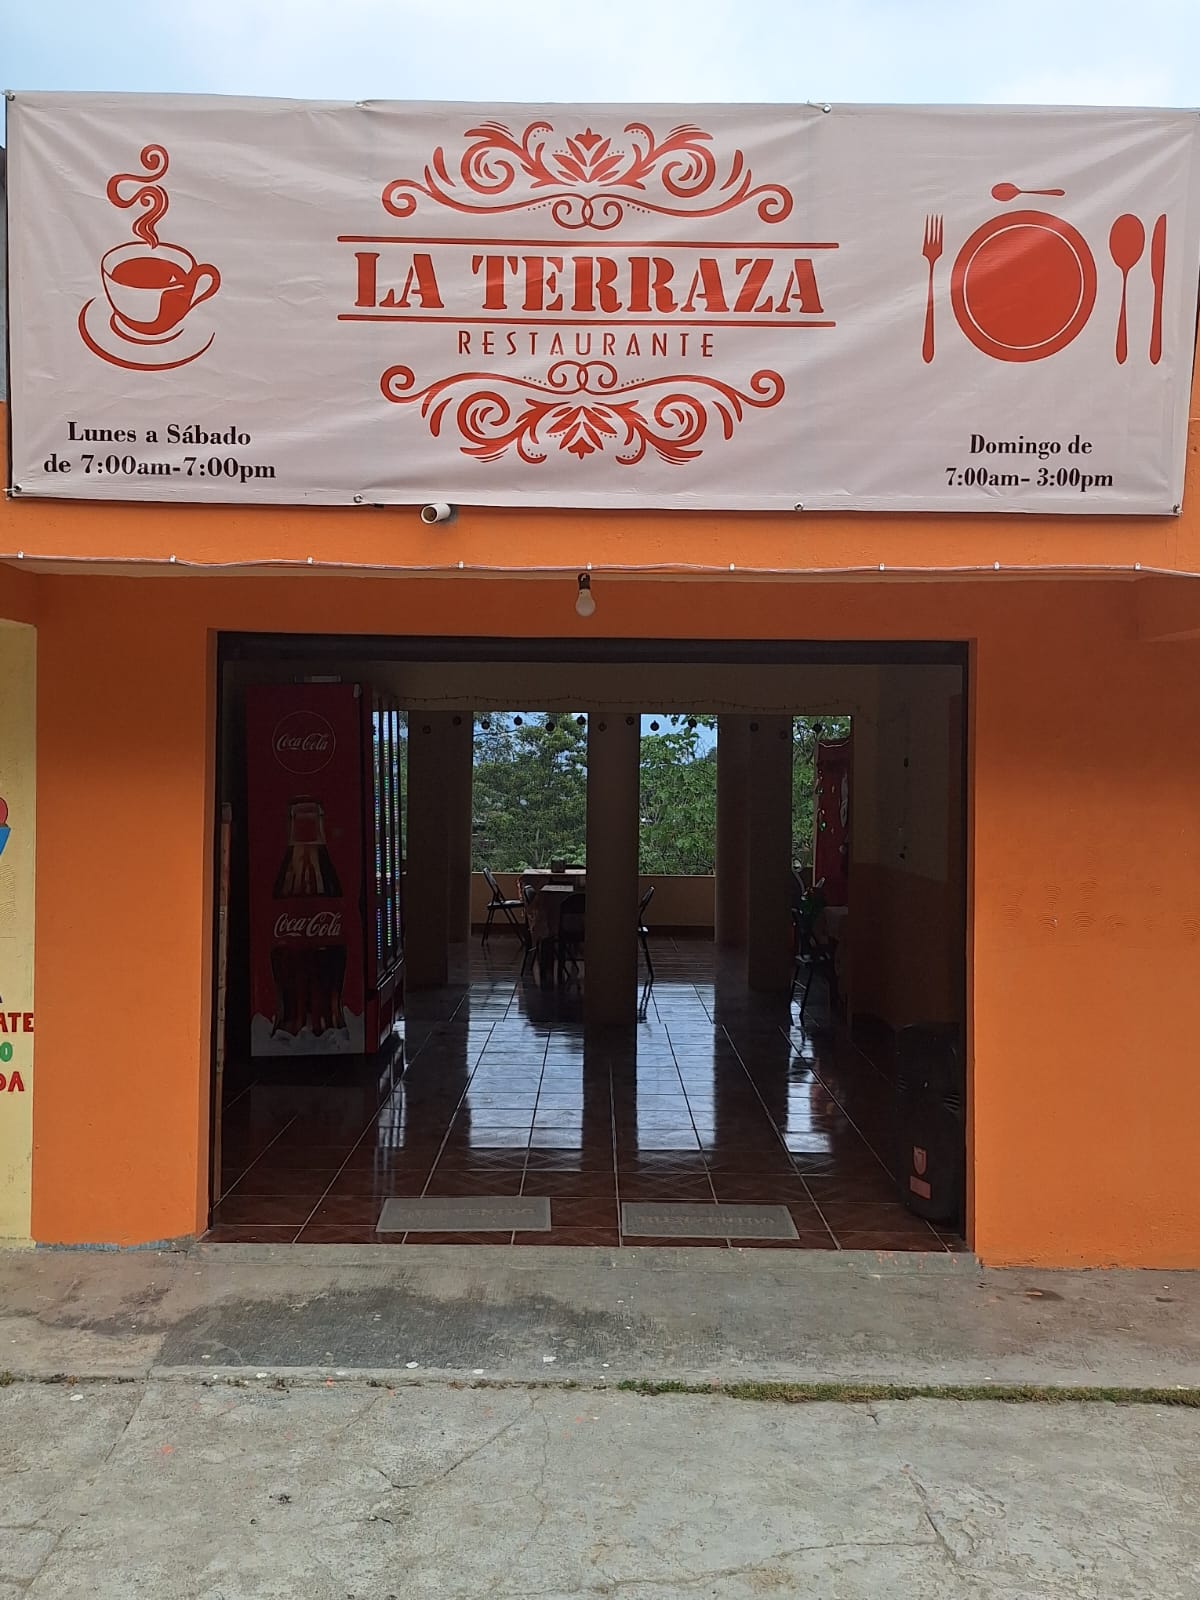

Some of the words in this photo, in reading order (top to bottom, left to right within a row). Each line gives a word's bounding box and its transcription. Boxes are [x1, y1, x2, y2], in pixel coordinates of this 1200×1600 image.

[354, 252, 445, 309] LA
[471, 255, 825, 313] TERRAZA
[457, 330, 714, 358] RESTAURANTE
[67, 421, 137, 443] Lunes
[145, 429, 158, 443] a
[167, 423, 251, 445] Sábado
[969, 434, 1061, 460] Domingo
[1067, 434, 1093, 454] de
[43, 453, 71, 474] de
[80, 453, 276, 483] 7:00am-7:00pm
[1036, 467, 1113, 492] 3:00pm
[273, 911, 343, 938] Coca-Cola
